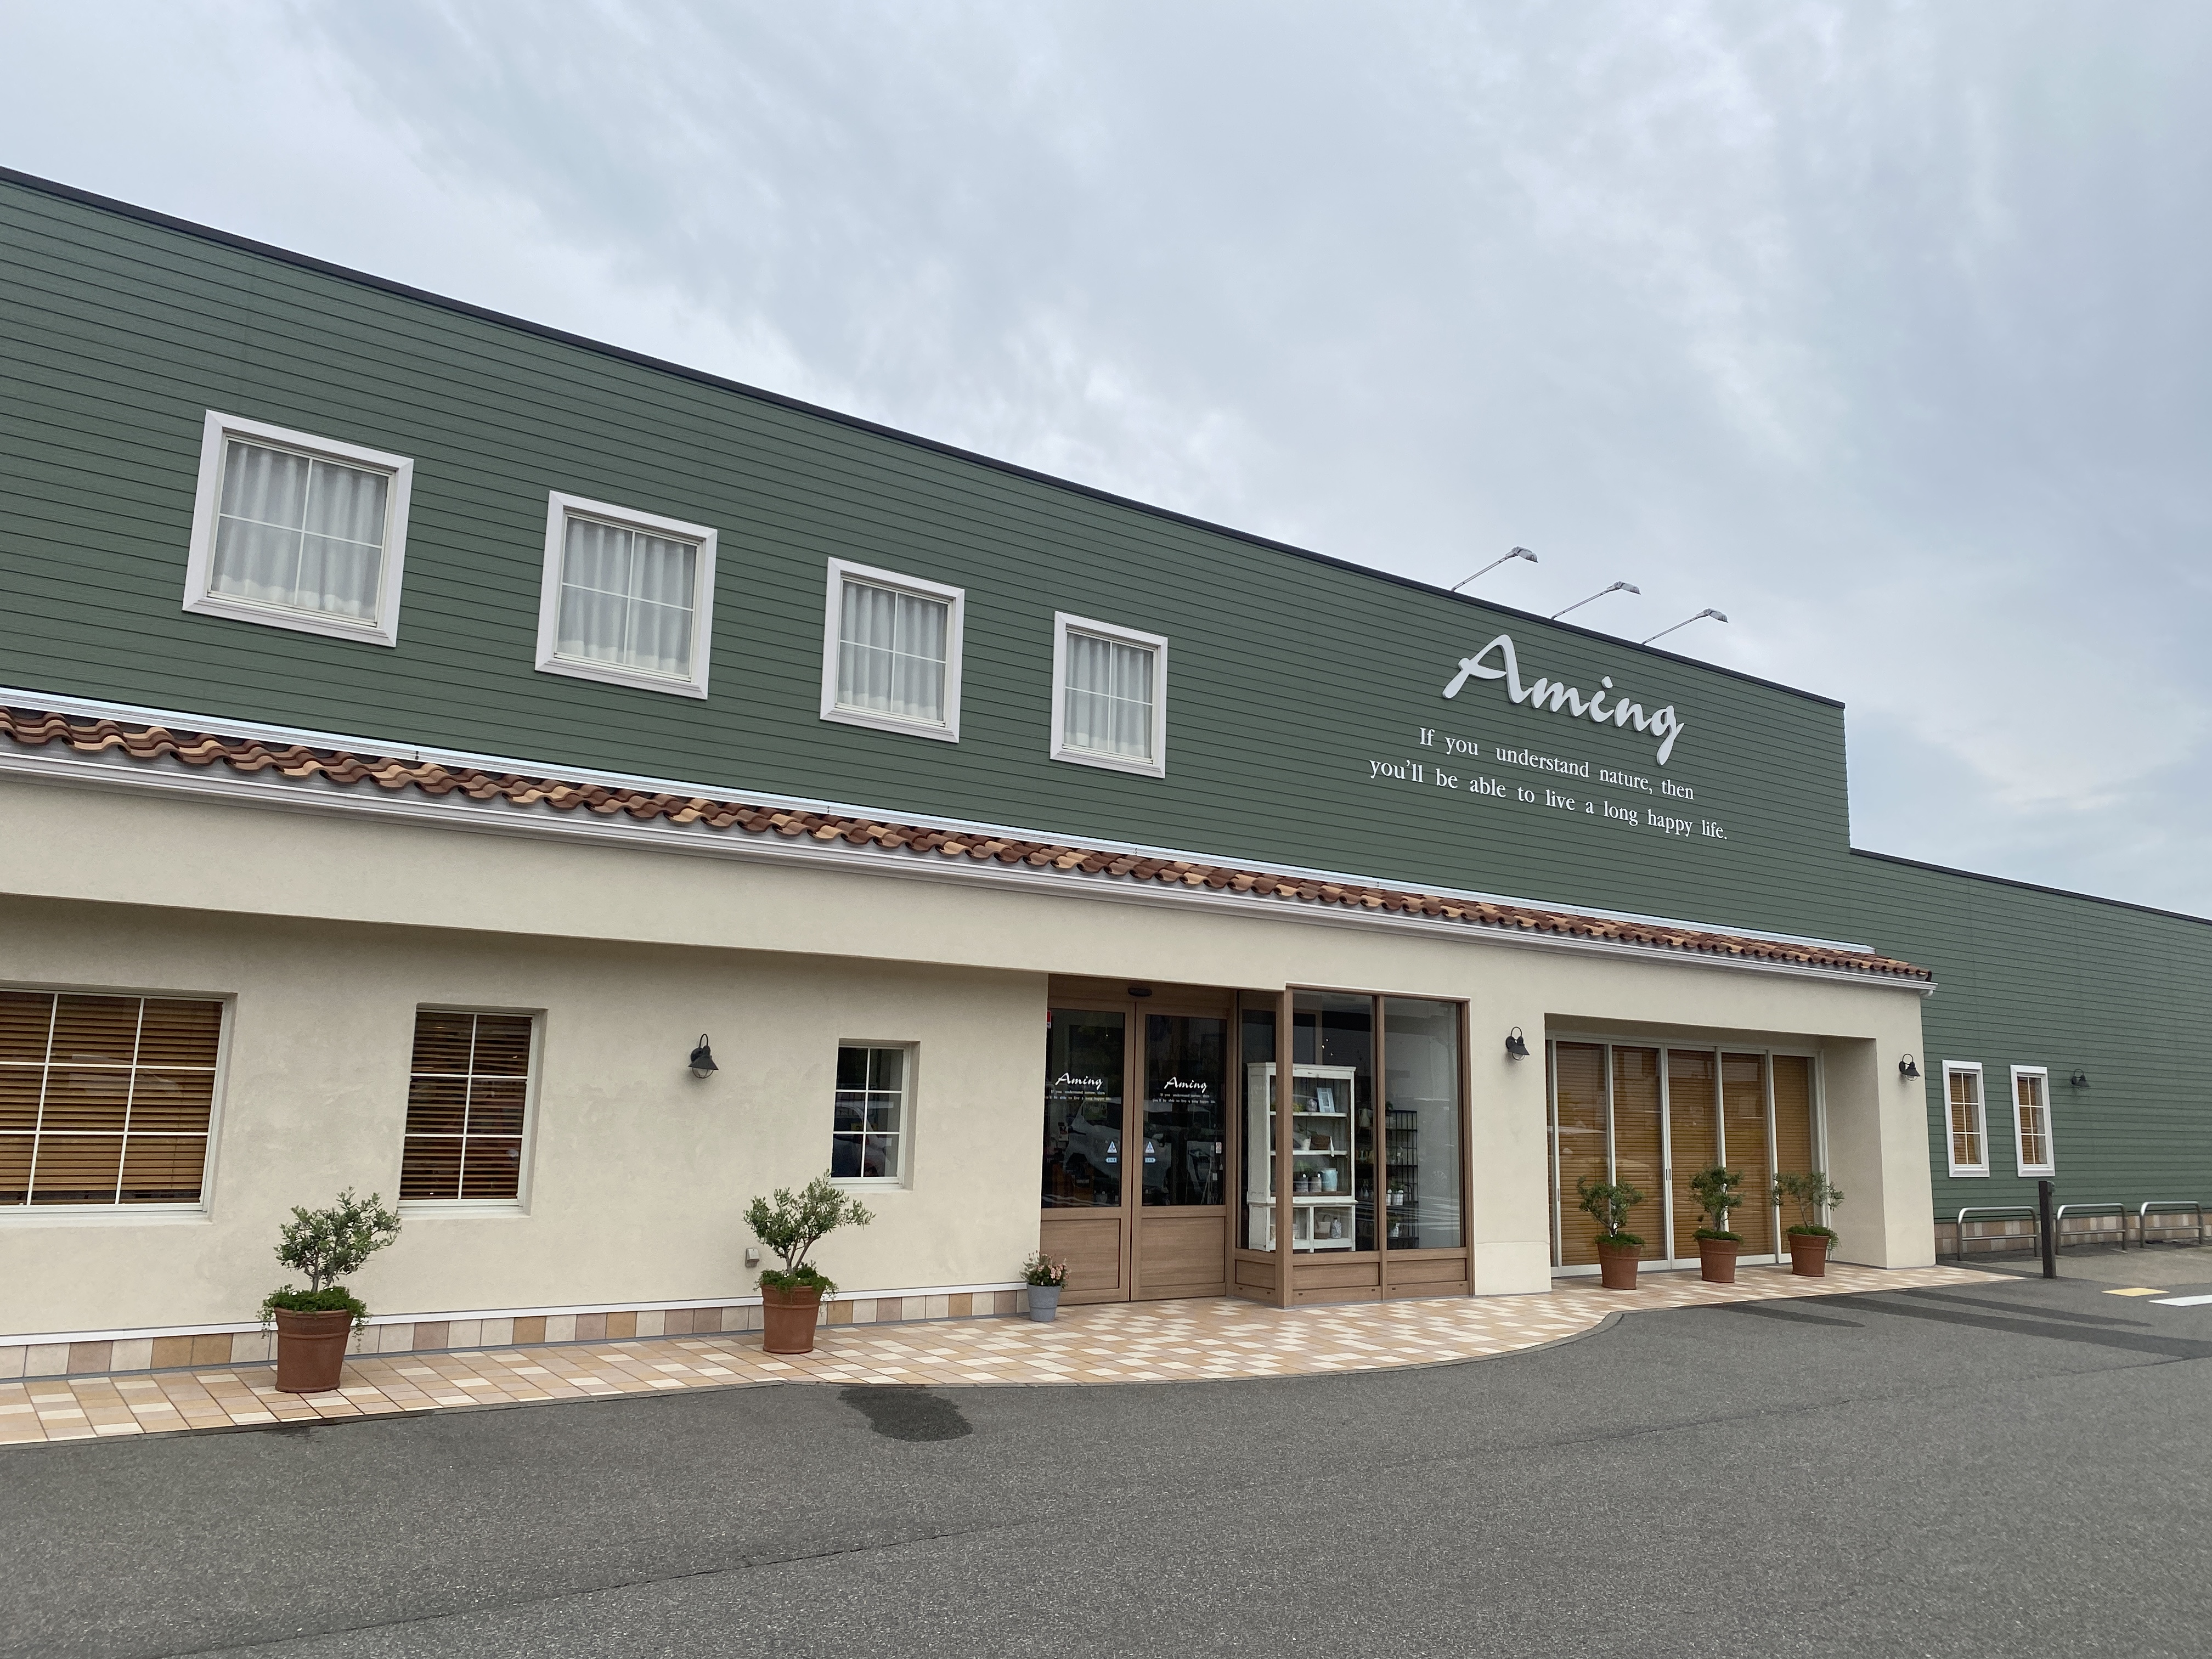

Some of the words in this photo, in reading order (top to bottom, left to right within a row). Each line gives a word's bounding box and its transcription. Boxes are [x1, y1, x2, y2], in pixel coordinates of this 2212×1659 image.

[1442, 634, 1685, 766] Aming
[1369, 760, 1424, 783] you'll
[1435, 768, 1458, 789] be
[1469, 776, 1506, 798] able
[1517, 787, 1535, 803] to
[1545, 789, 1576, 810] live
[1585, 802, 1595, 814] a
[1604, 800, 1638, 826] long
[1647, 809, 1693, 836] happy
[1701, 820, 1728, 840] life.
[1419, 727, 1435, 747] If
[1444, 737, 1479, 755] you
[1496, 747, 1590, 778] understand
[1599, 769, 1652, 794] nature,
[1661, 780, 1695, 800] then
[1055, 1072, 1103, 1090] Aming
[1164, 1076, 1207, 1093] Aming
